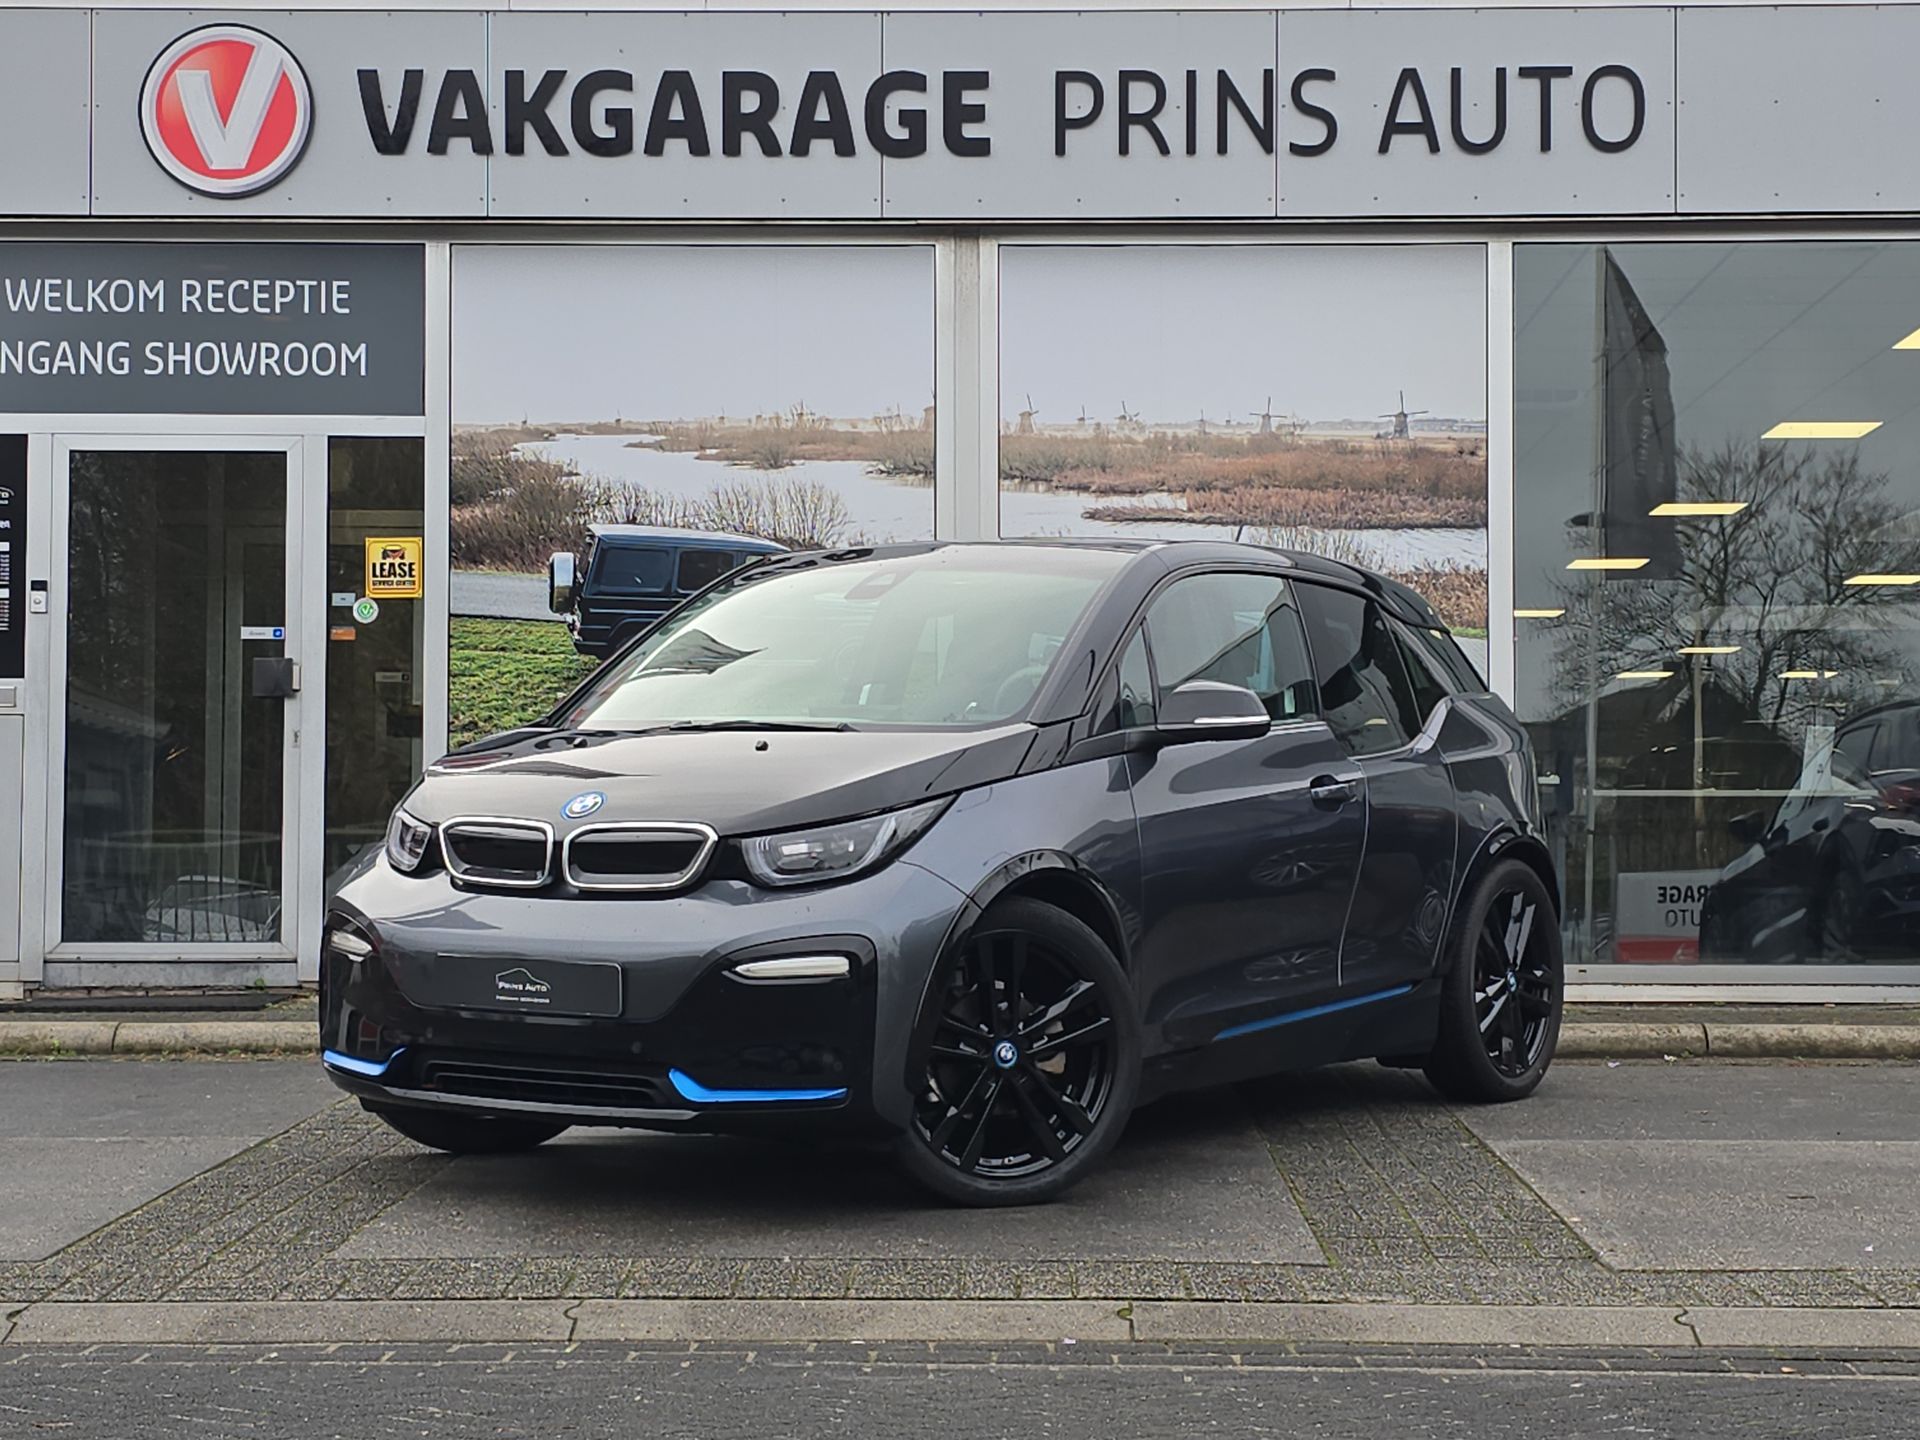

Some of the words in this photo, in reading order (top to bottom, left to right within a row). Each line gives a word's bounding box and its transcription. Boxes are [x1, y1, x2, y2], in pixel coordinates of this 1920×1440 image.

[357, 69, 990, 158] VAKGARAGE
[1055, 69, 1337, 157] PRINS
[1379, 65, 1645, 155] AUTO
[5, 279, 163, 312] WELKOM
[182, 280, 349, 313] RECEPTIE
[144, 342, 366, 375] SHOWROOM
[372, 562, 416, 578] LEASE
